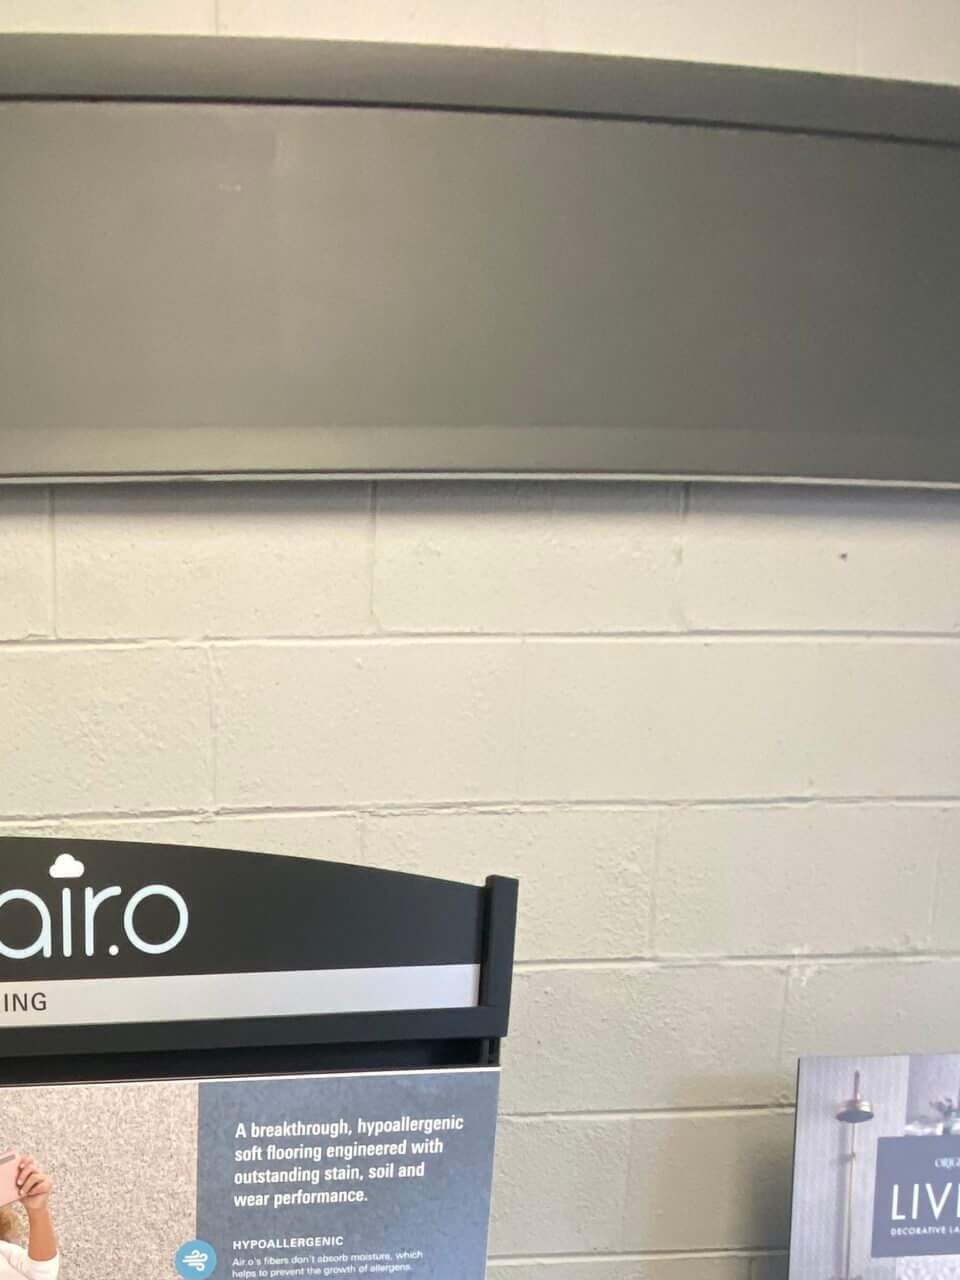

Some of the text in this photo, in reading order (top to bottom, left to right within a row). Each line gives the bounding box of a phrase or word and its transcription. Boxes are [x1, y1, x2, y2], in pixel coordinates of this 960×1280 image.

[235, 1115, 464, 1139] A breakthrough, hypoallergenic
[234, 1138, 444, 1162] soft flooring engineered with
[234, 1162, 425, 1185] outstanding stain, soil and
[233, 1189, 368, 1209] wear performance.
[891, 1182, 960, 1220] LIV
[890, 1225, 946, 1236] DECORATIVE
[232, 1236, 344, 1251] HYPOALLERGENIC
[263, 1255, 289, 1265] fibers
[291, 1254, 316, 1264] don't
[317, 1253, 349, 1263] absorb
[351, 1252, 393, 1262] moisture,
[395, 1249, 424, 1260] which
[231, 1269, 257, 1279] helps
[258, 1268, 268, 1278] to
[269, 1267, 304, 1278] prevent
[307, 1266, 322, 1275] the
[323, 1264, 356, 1277] growth
[358, 1263, 368, 1274] of
